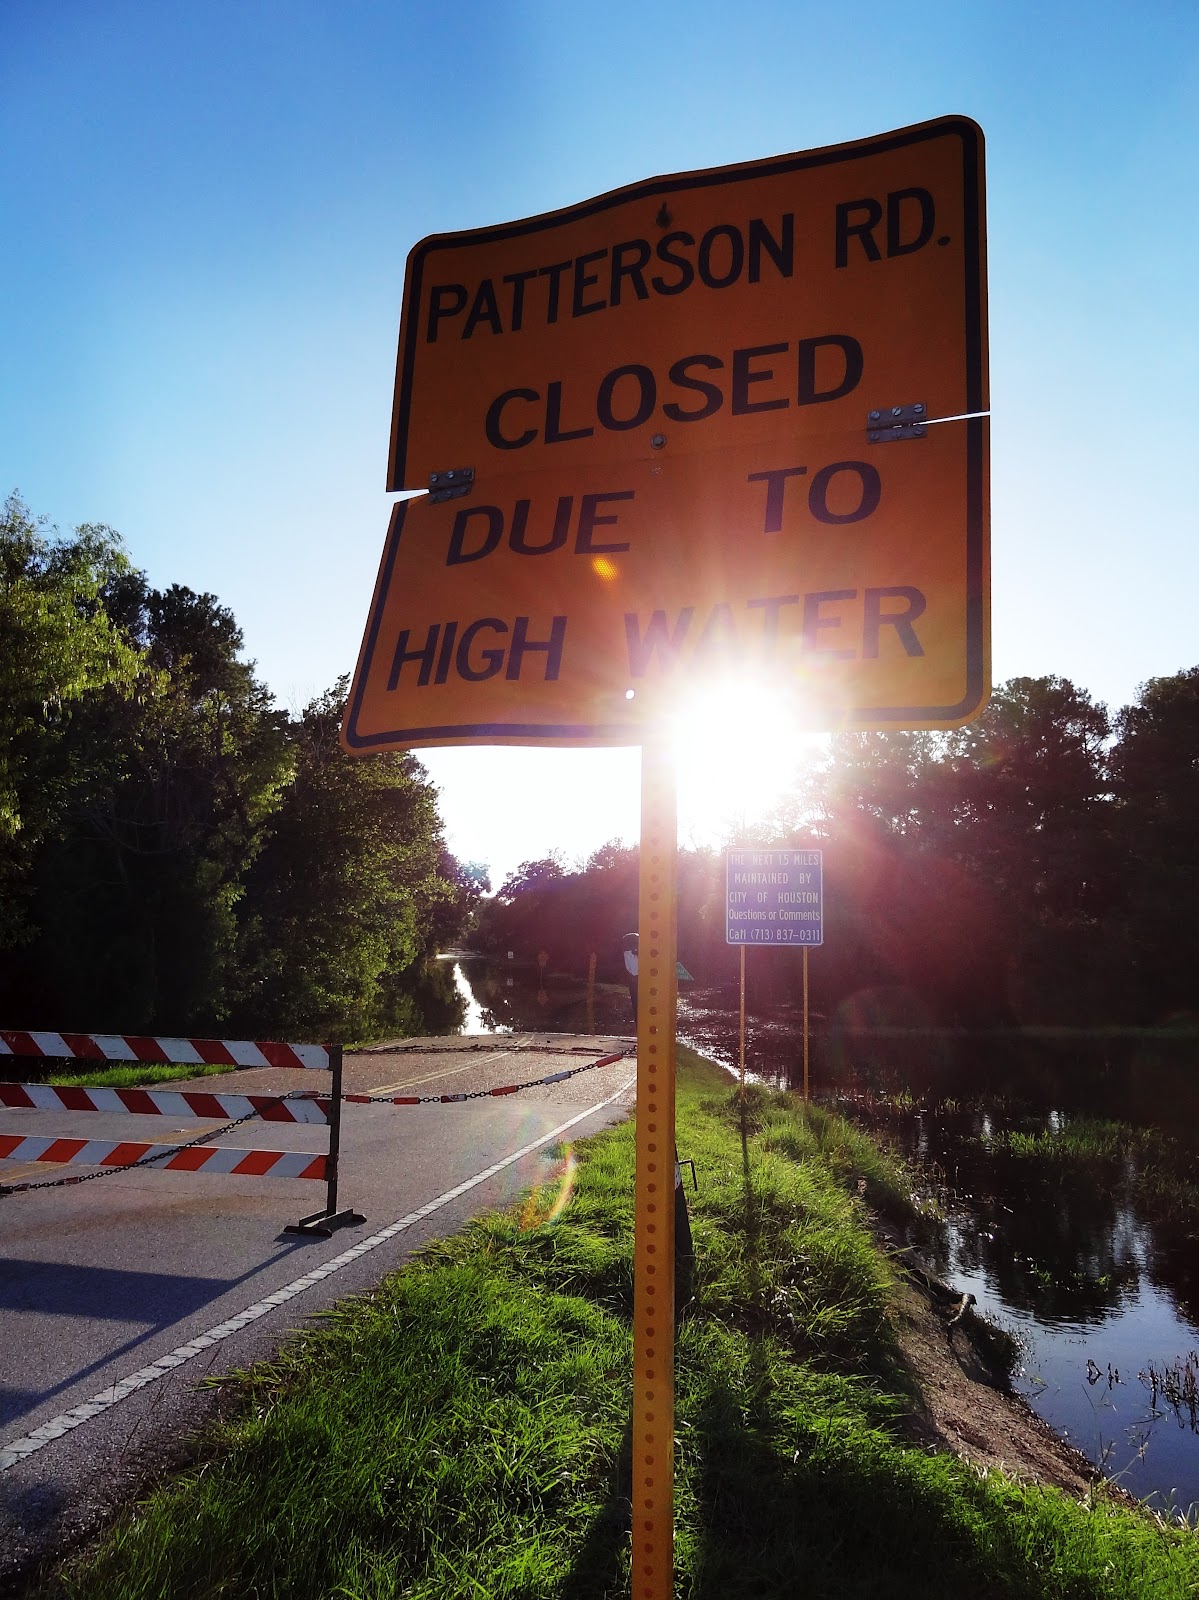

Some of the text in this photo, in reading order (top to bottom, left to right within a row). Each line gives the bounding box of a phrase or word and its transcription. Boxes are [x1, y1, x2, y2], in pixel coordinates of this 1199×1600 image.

[425, 187, 952, 343] PATTERSON RD.
[485, 334, 864, 450] CLOSED
[446, 460, 882, 566] DUE TO
[386, 586, 928, 692] HIGH WATER
[730, 854, 744, 866] THE
[752, 854, 773, 866] NEXT
[794, 854, 819, 866] MILES
[734, 872, 812, 884] MAINTAINED BY
[729, 891, 819, 904] CITY OF HOUSTON
[728, 909, 821, 921] Questions or Comments
[729, 928, 820, 941] Call (713) 837-0311
